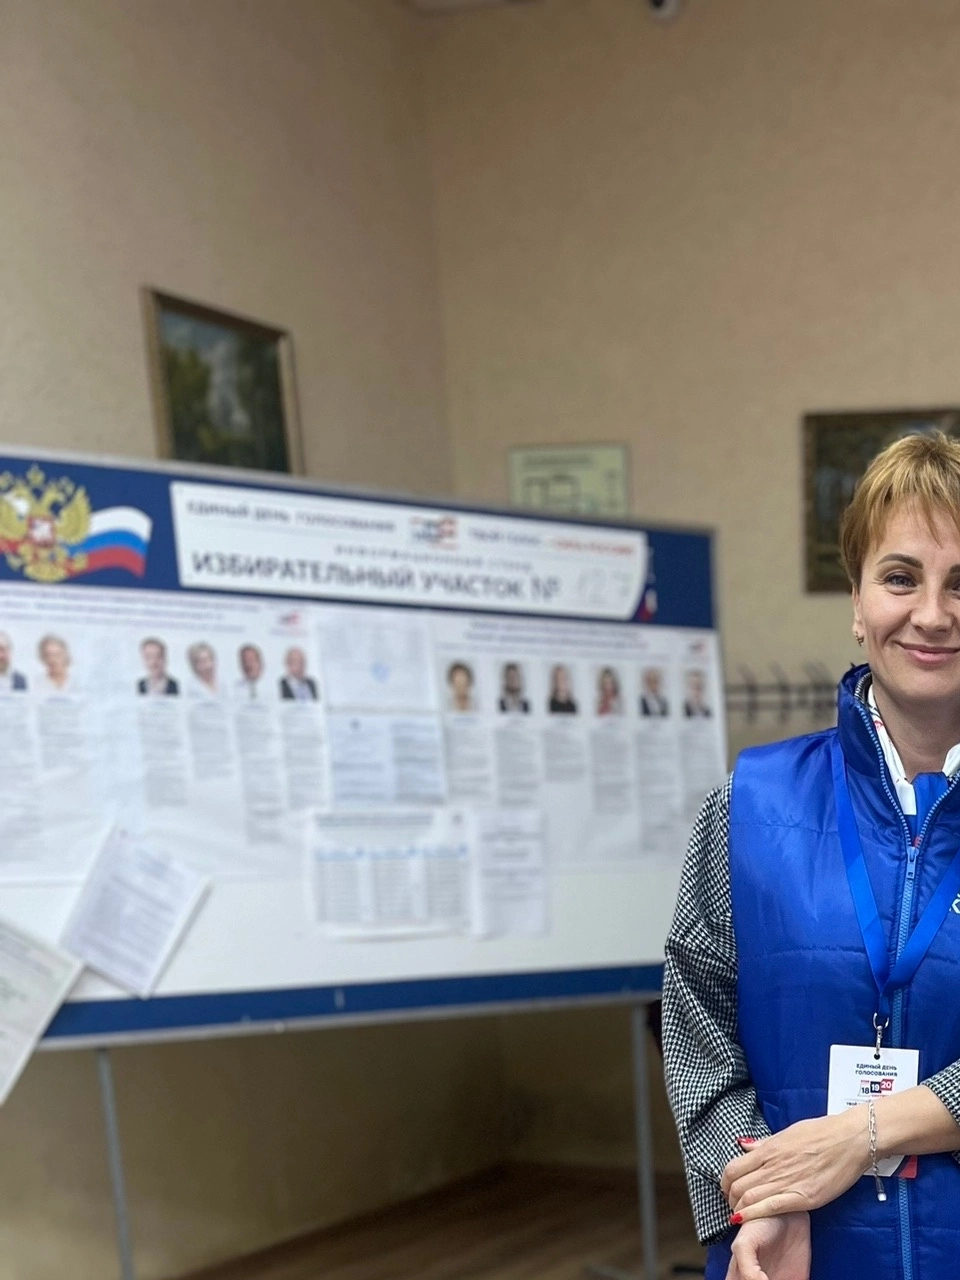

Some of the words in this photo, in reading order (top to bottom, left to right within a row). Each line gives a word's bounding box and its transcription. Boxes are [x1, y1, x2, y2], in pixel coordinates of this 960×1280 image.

[191, 550, 415, 590] ИЗБИРАТЕЛЬНЫЙ
[420, 569, 522, 598] УЧАСТОК
[871, 1083, 881, 1092] 19
[881, 1081, 892, 1089] 20
